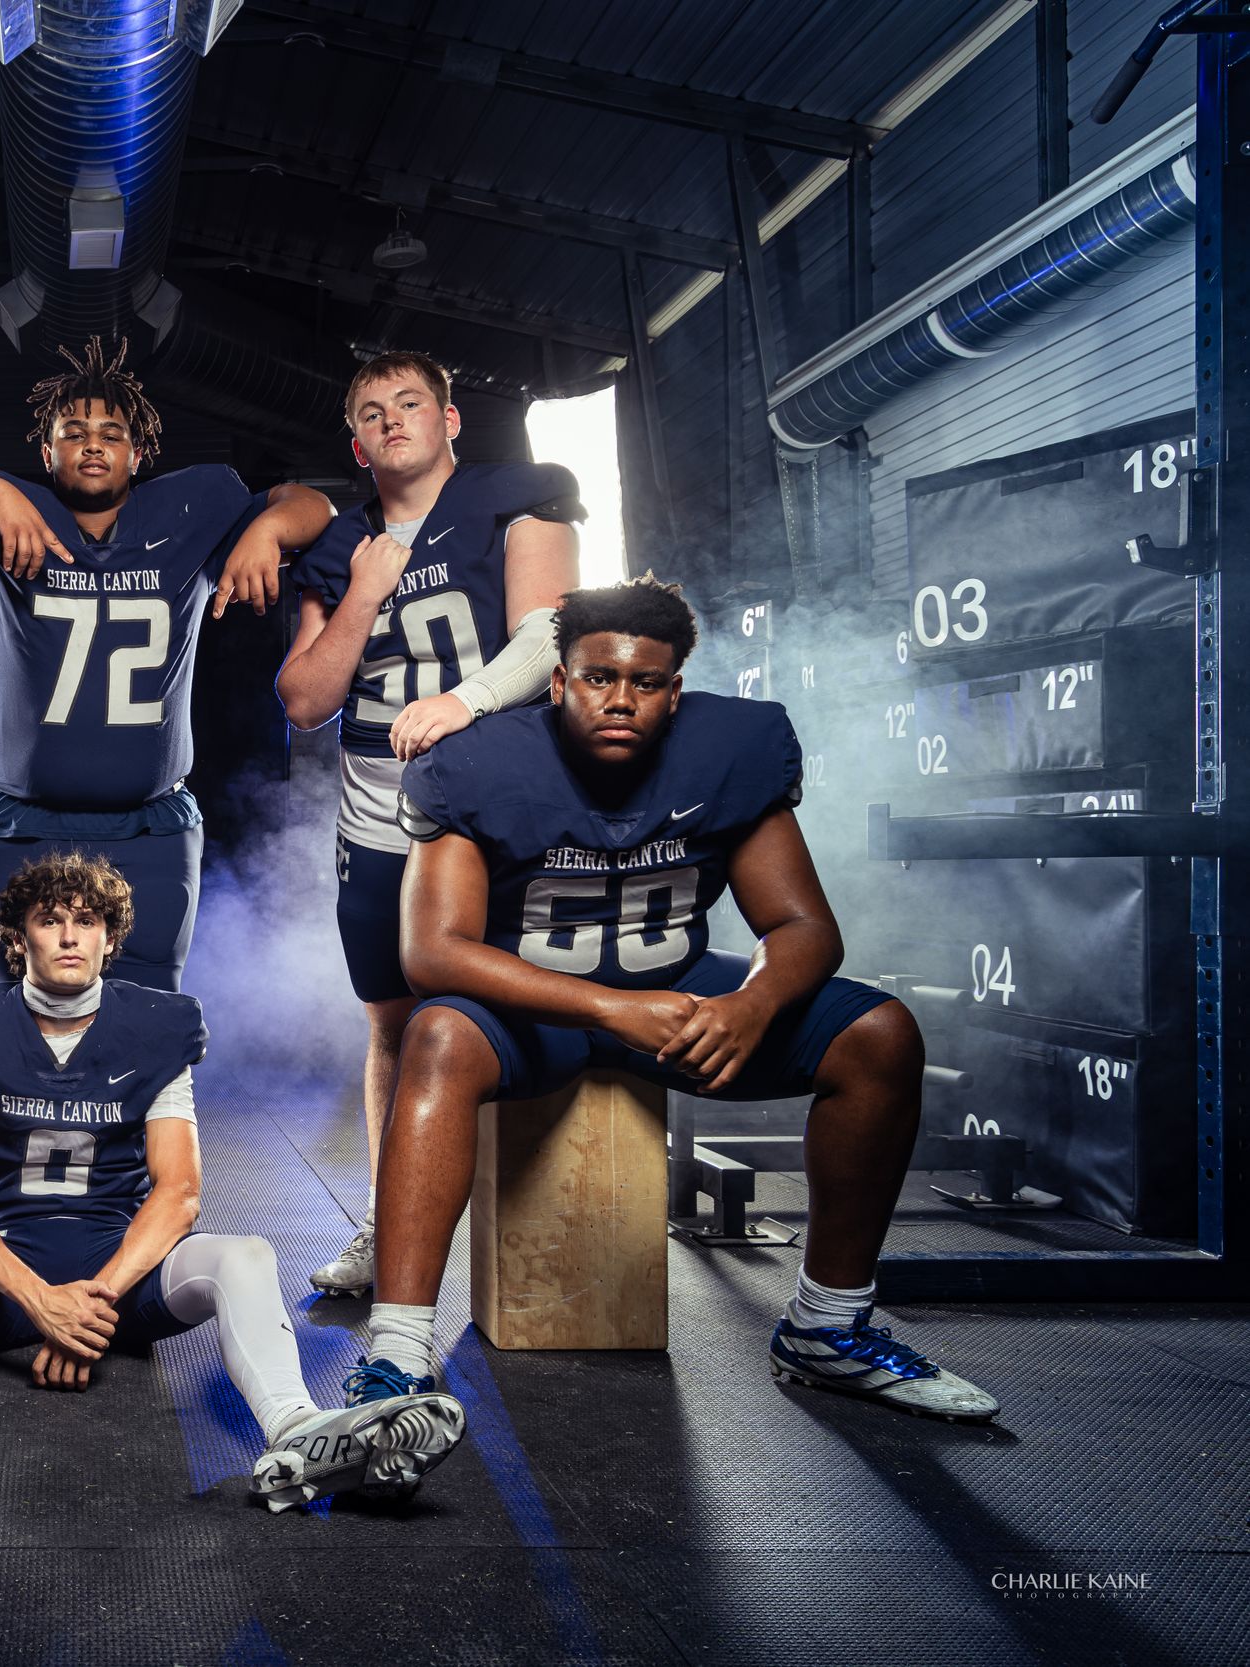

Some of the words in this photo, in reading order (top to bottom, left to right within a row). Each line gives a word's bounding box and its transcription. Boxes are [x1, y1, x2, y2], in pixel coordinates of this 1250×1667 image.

[1124, 438, 1197, 493] 18"
[47, 569, 98, 591] SIERRA
[103, 570, 160, 591] CANYON
[395, 562, 449, 597] ANYON
[742, 606, 765, 637] 6"
[914, 578, 988, 647] 03
[33, 592, 170, 726] 72
[802, 664, 814, 689] 01
[737, 666, 760, 698] 12"
[1042, 664, 1093, 711] 12"
[885, 703, 915, 739] 12"
[806, 754, 826, 787] 02
[918, 734, 948, 775] 02
[544, 847, 610, 870] SIERRA
[617, 837, 687, 869] CANYON
[518, 866, 699, 974] 60
[972, 943, 1016, 1006] 04
[1078, 1056, 1128, 1100] 18"
[1, 1094, 55, 1120] SIERRA
[62, 1101, 122, 1123] CANYON
[20, 1129, 96, 1196] 0
